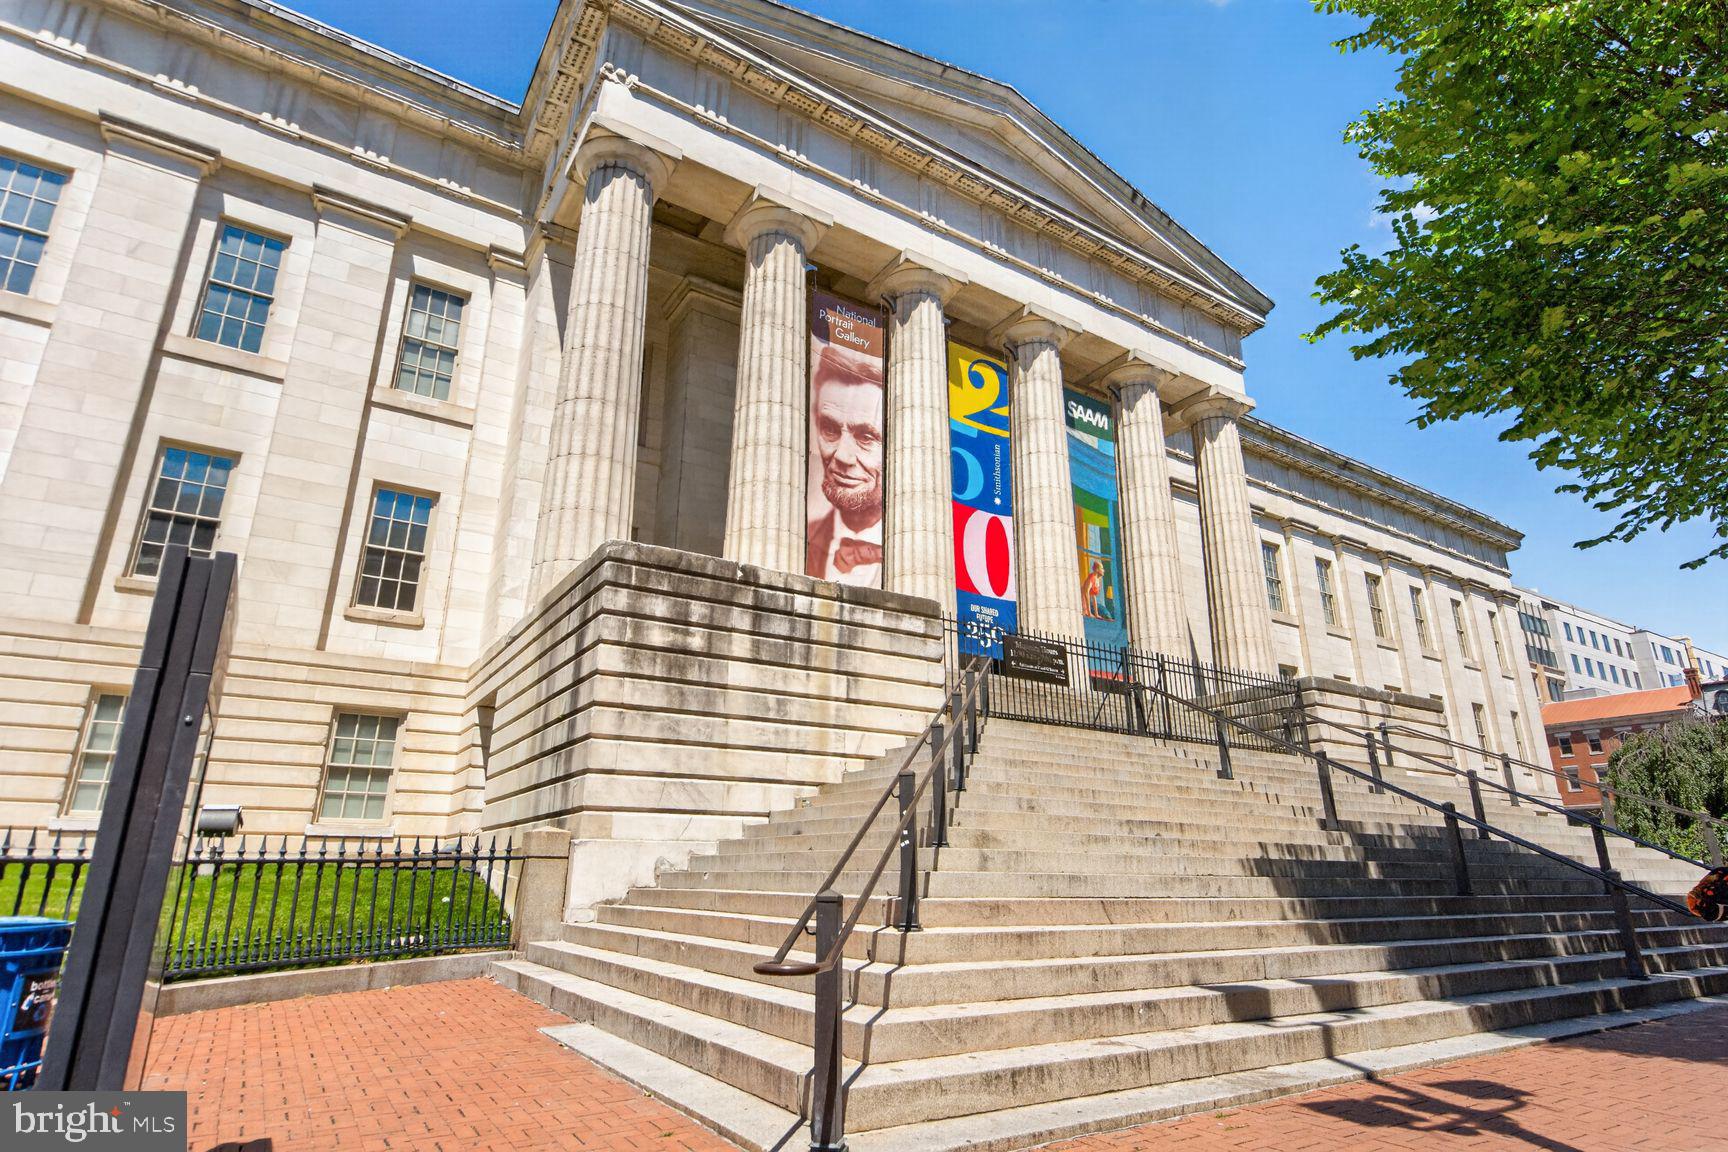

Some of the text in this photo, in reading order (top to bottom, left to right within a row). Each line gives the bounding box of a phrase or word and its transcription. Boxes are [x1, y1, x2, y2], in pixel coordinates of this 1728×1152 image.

[820, 309, 854, 330] Portrait
[836, 305, 876, 328] National
[835, 328, 871, 349] Gallery
[1067, 400, 1108, 430] SAAM
[970, 603, 980, 613] OUR
